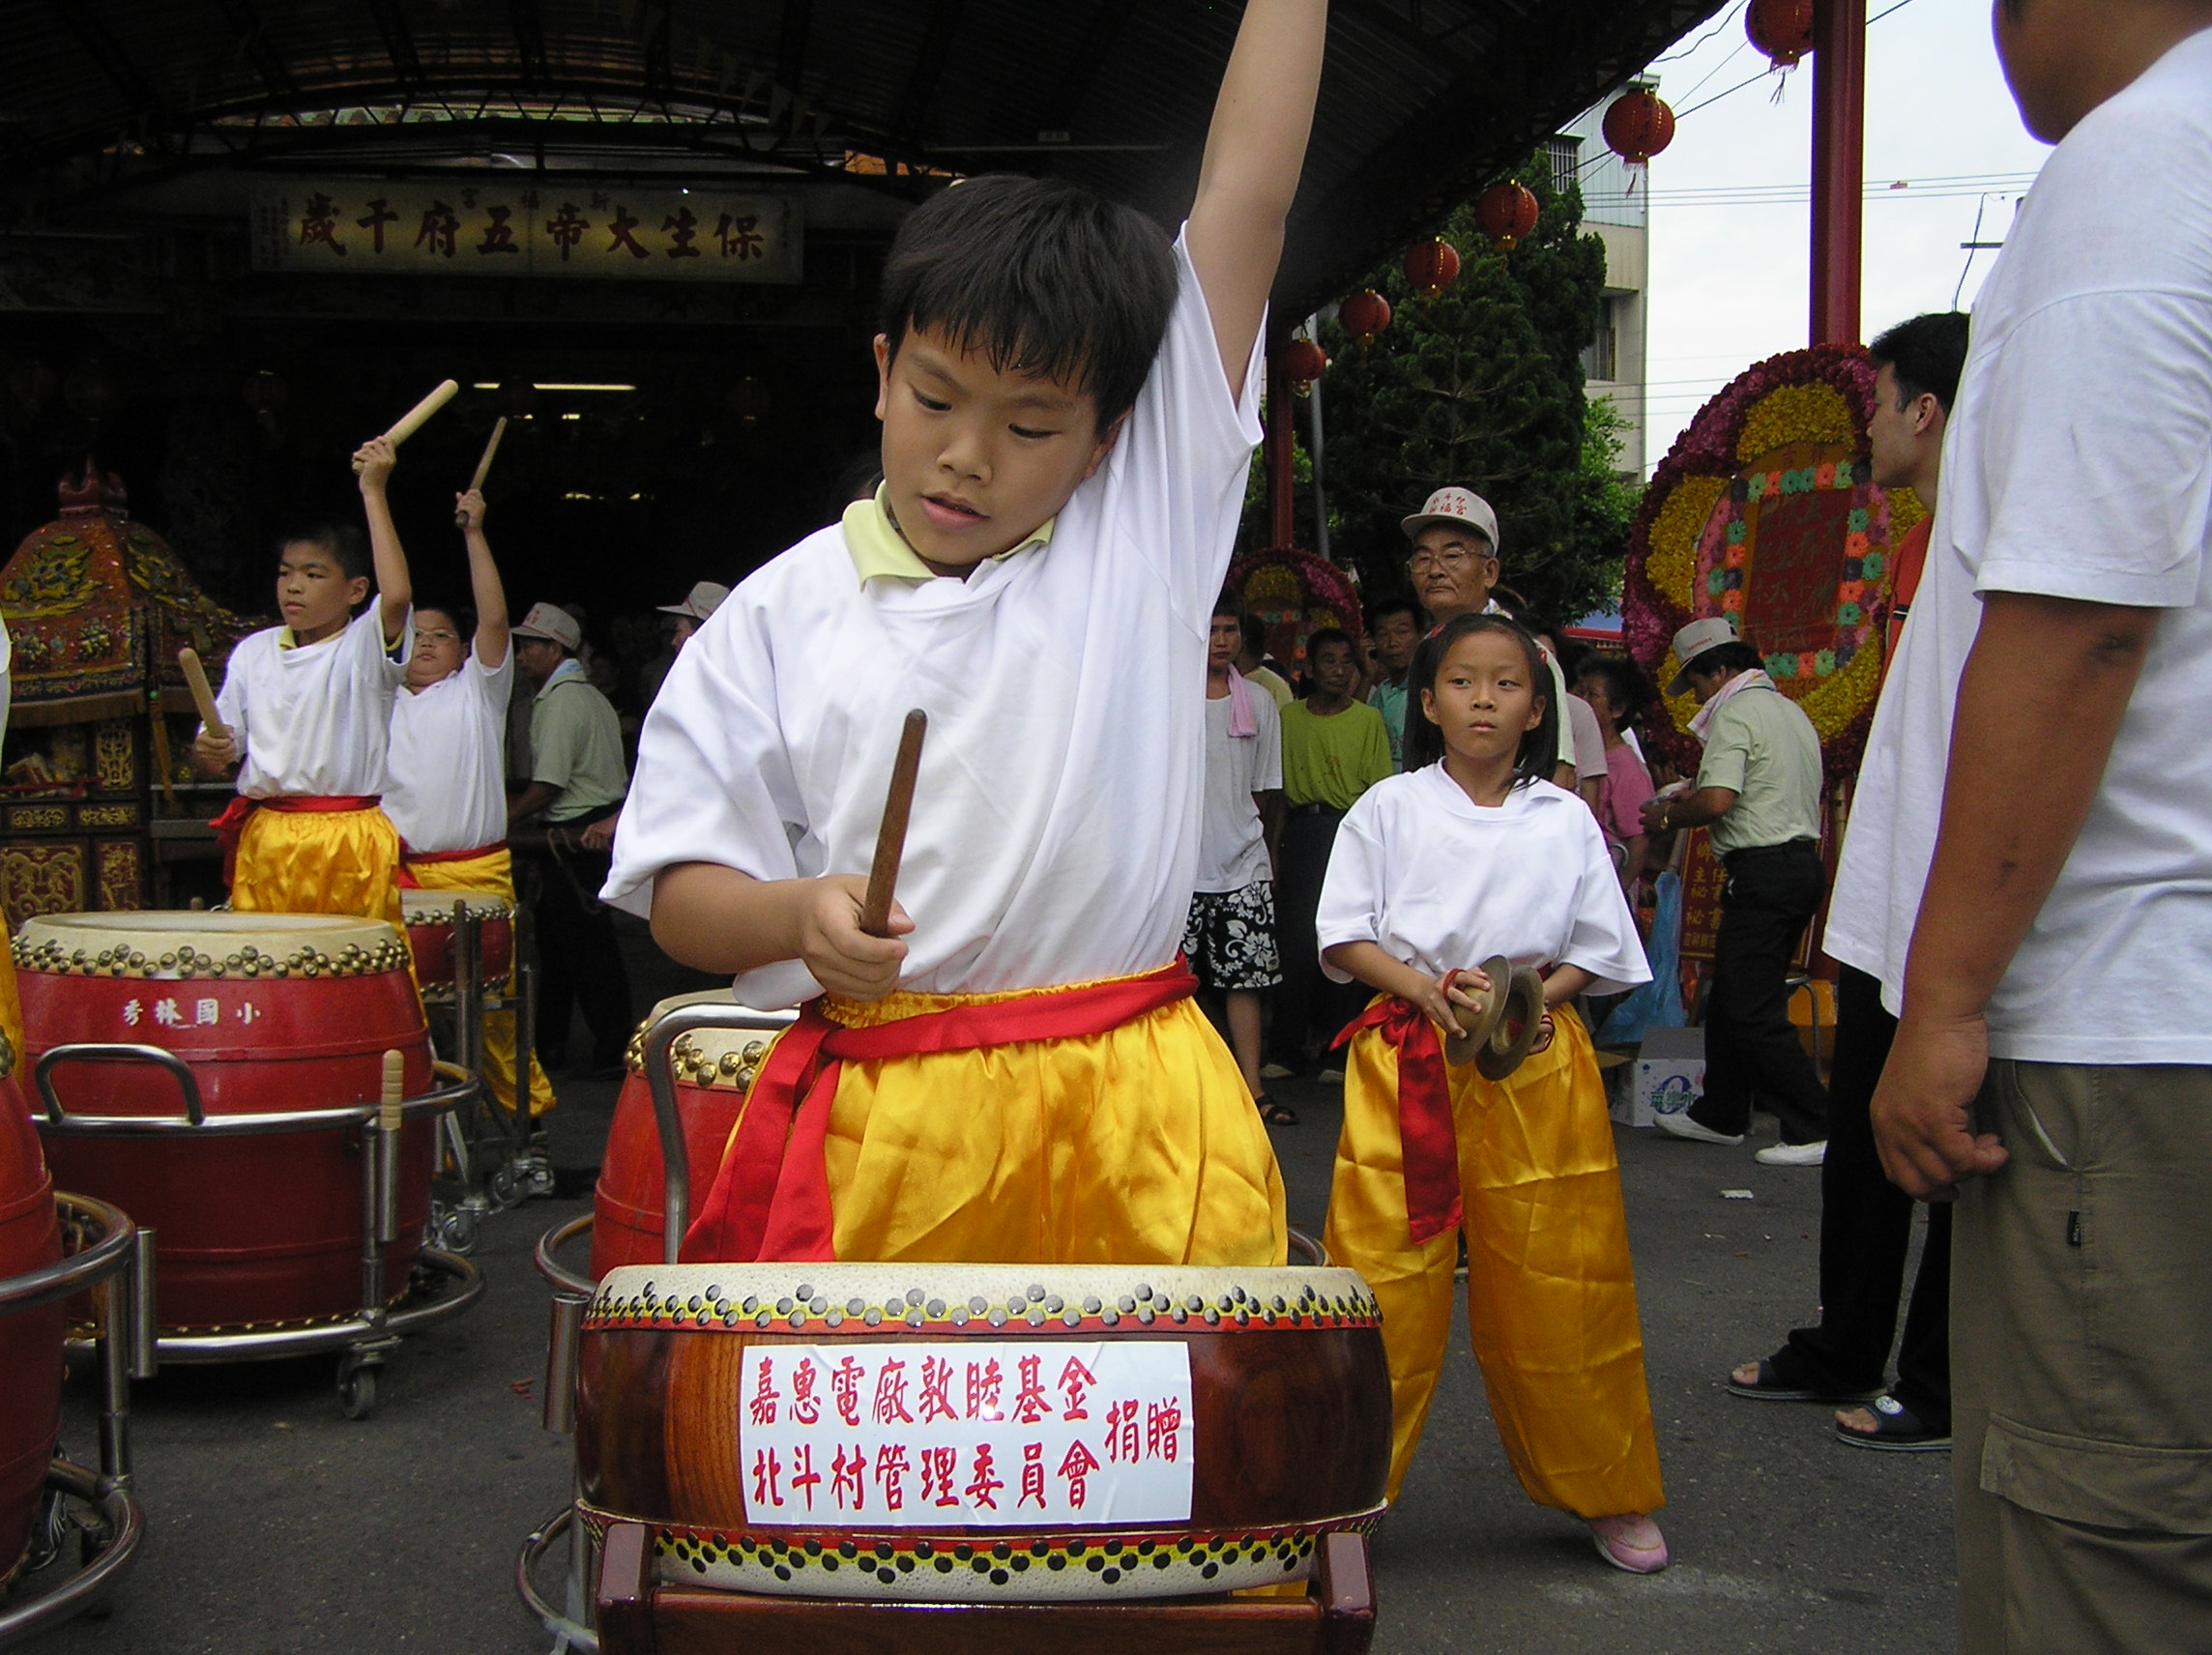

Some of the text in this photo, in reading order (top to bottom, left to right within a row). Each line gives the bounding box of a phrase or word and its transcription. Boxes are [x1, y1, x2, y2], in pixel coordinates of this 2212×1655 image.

[748, 1352, 1098, 1427] 嘉惠電廠敦睦基金
[1104, 1395, 1182, 1465] 捐贈
[751, 1438, 1100, 1513] 北斗村管理委員會
